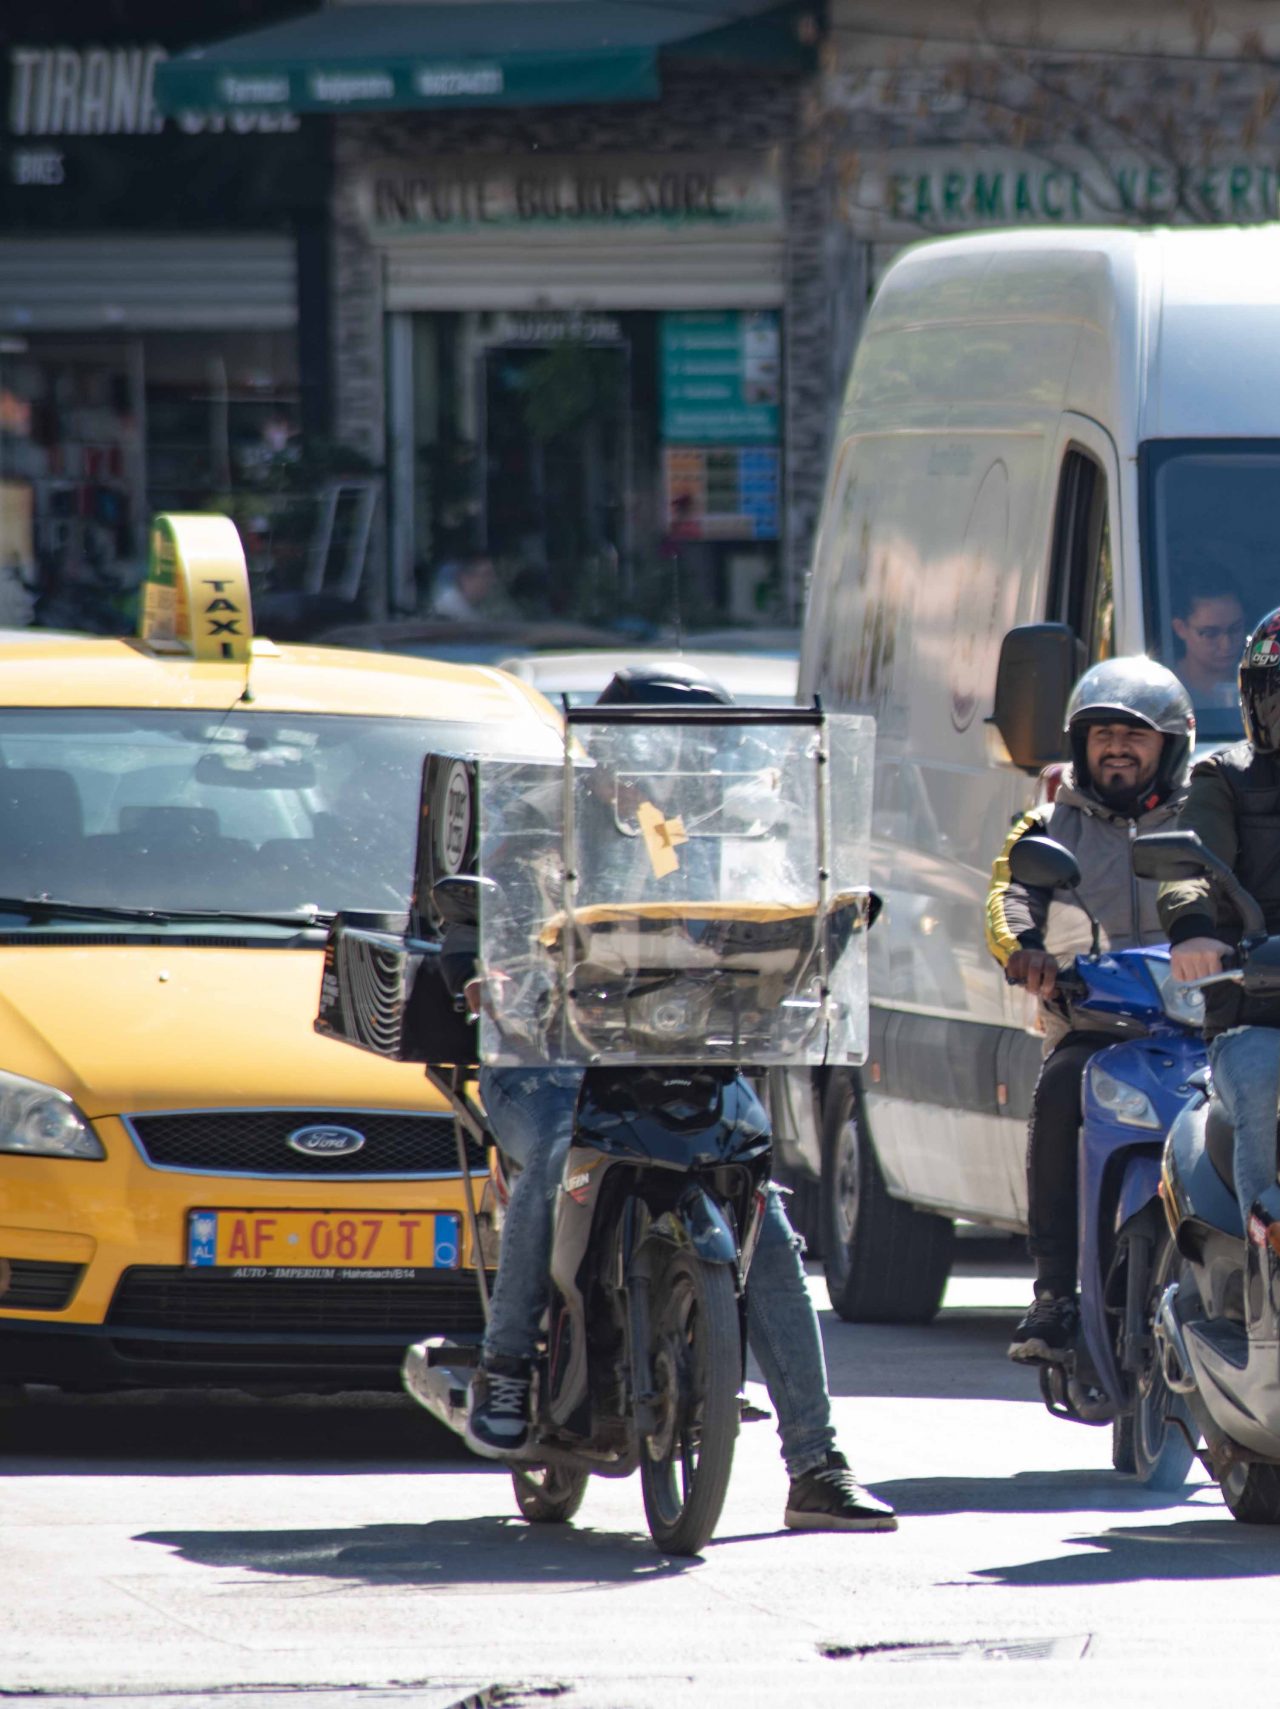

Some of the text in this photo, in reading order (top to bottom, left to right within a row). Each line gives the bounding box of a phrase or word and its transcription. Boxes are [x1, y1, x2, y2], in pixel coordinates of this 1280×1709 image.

[201, 580, 242, 659] TAXI
[1252, 652, 1280, 665] agv
[307, 1131, 348, 1149] Ford
[195, 1218, 421, 1260] AL AF 087 T
[233, 1268, 267, 1278] AUTO
[274, 1268, 336, 1279] IMPERIUM
